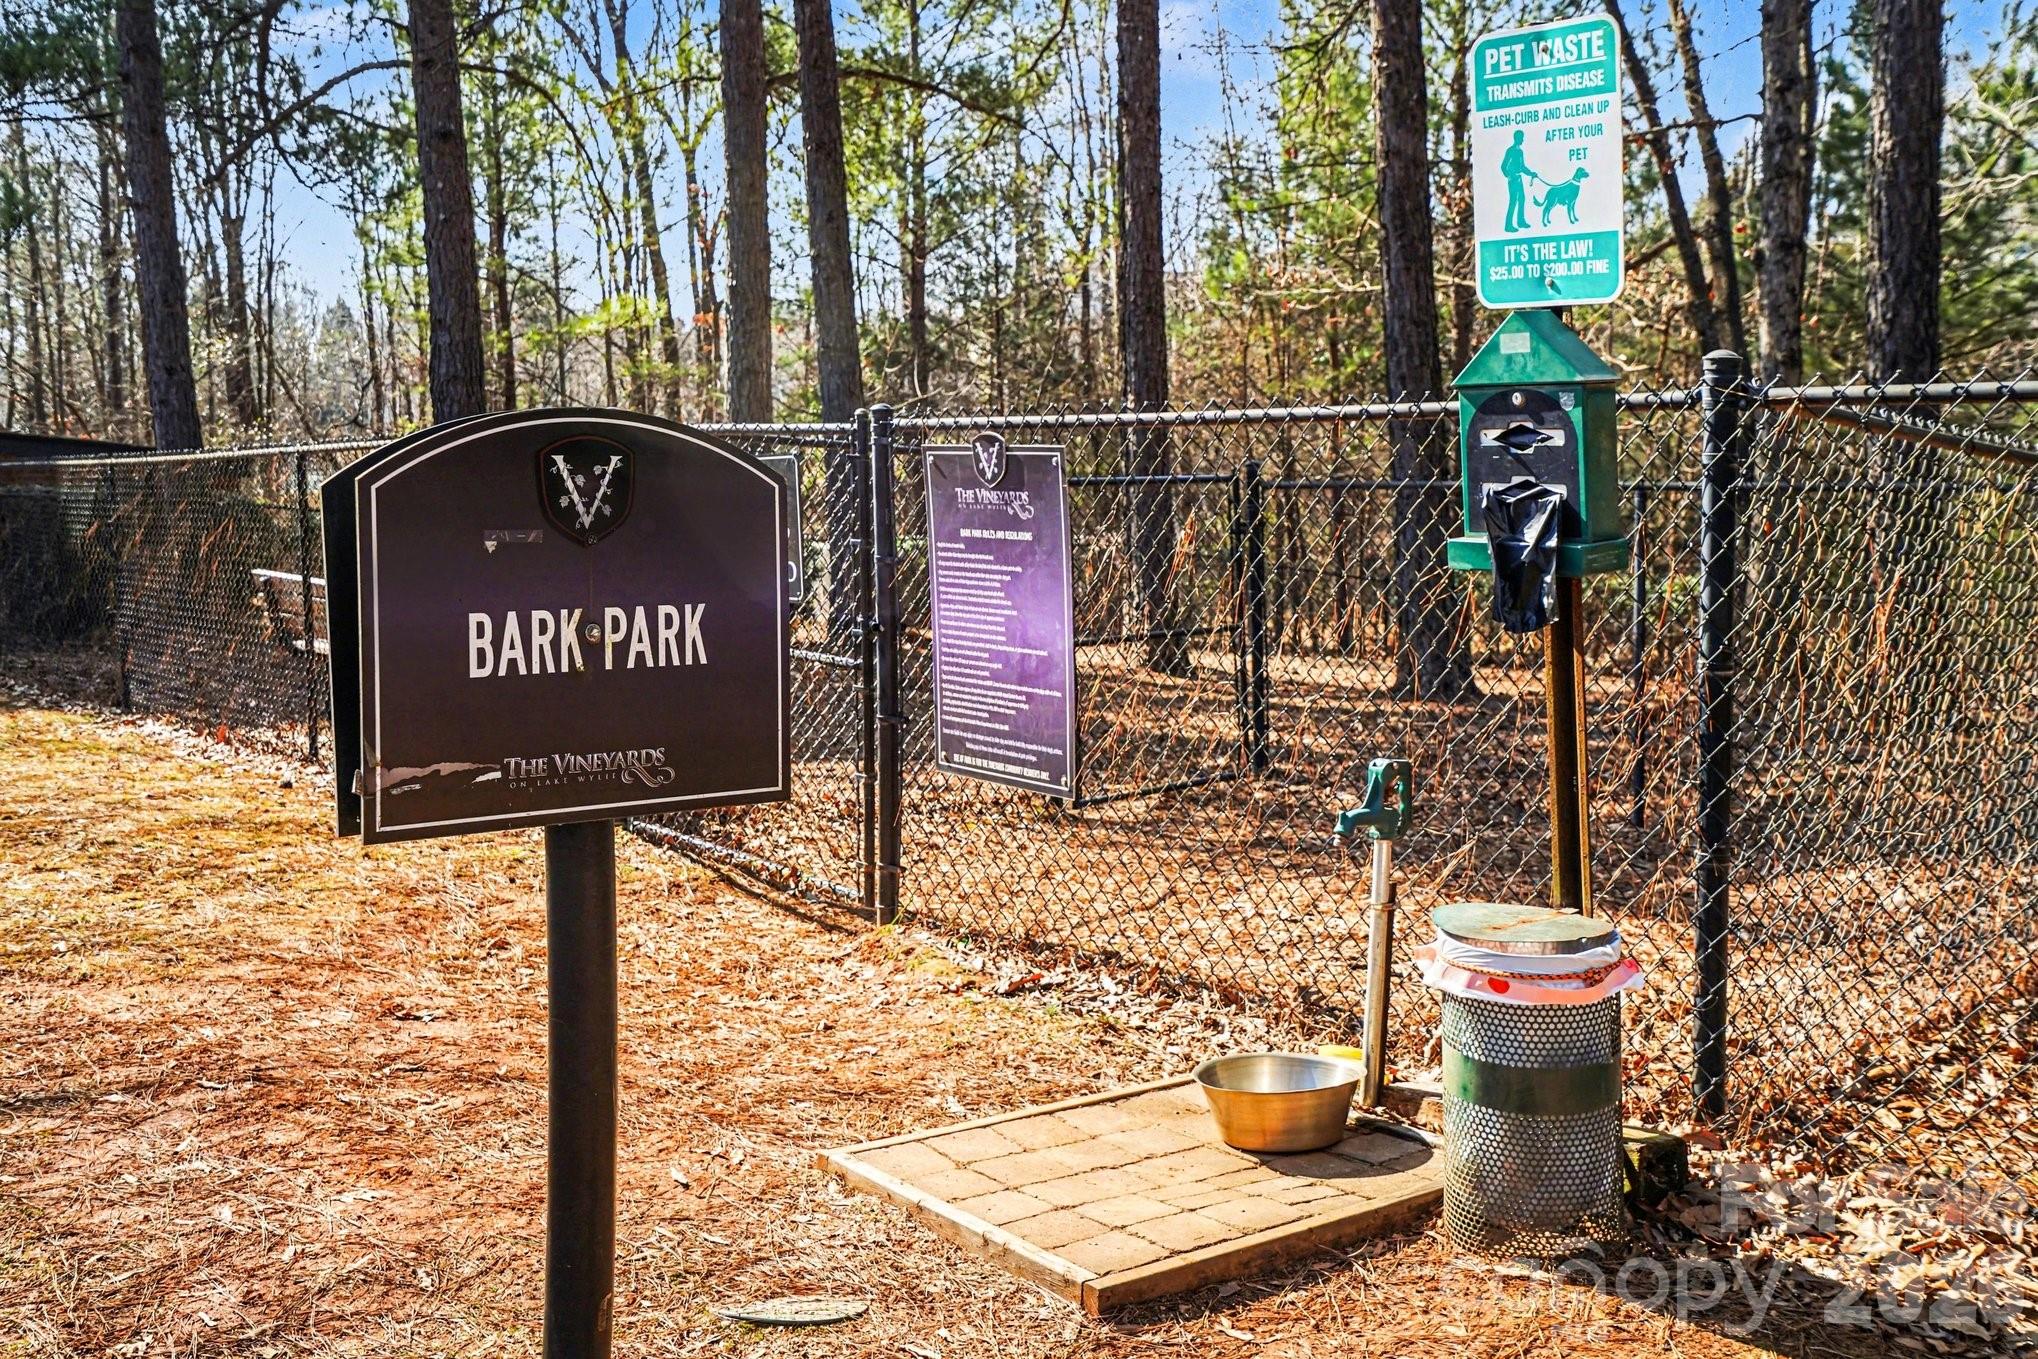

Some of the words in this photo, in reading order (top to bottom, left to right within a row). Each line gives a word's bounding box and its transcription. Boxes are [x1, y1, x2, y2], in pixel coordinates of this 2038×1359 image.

[1485, 43, 1524, 75] PET
[1531, 30, 1605, 67] WASTE
[1486, 77, 1553, 102] TRANSMITS
[1556, 69, 1605, 92] DISEASE
[1483, 110, 1540, 129] LEASH-CURB
[1543, 107, 1560, 122] AND
[1564, 102, 1594, 118] CLEAN
[1597, 100, 1610, 114] UP
[1545, 126, 1575, 143] AFTER
[1578, 123, 1604, 139] YOUR
[1569, 147, 1589, 162] PET
[1504, 244, 1529, 263] IT'S
[1532, 242, 1557, 261] THE
[1561, 239, 1594, 259] LAW!
[1489, 265, 1524, 282] $25.00
[1526, 263, 1540, 278] TO
[1543, 260, 1584, 277] $200.00
[1586, 259, 1610, 275] FINE
[955, 487, 975, 503] THE
[975, 487, 1034, 519] VINEYARDS
[468, 609, 586, 679] BARK
[604, 603, 708, 670] PARK
[503, 757, 549, 780] THE
[551, 747, 676, 788] VINEYARDS
[509, 781, 527, 789] ON
[537, 777, 568, 787] LAKE
